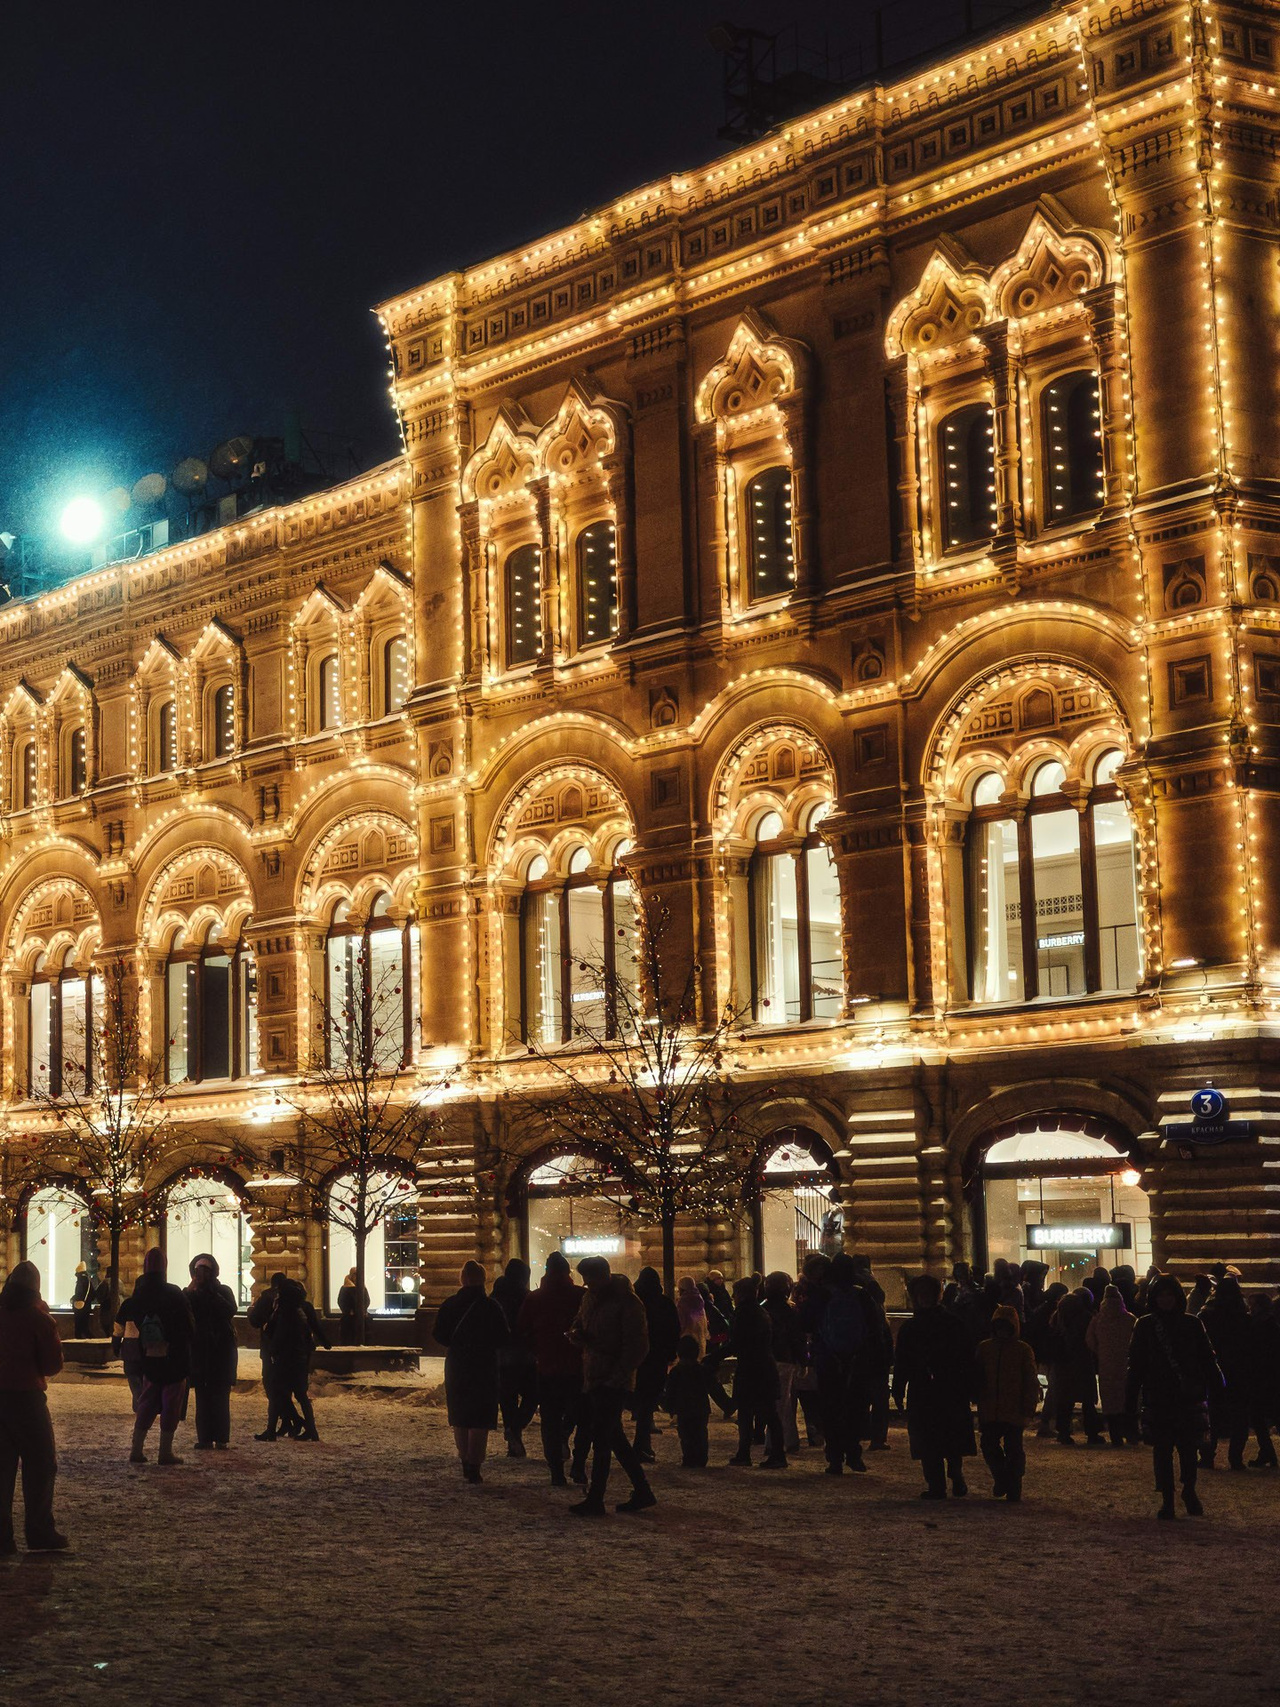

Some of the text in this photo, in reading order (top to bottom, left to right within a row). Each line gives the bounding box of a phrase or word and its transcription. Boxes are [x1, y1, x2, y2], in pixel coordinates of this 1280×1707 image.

[1039, 934, 1085, 949] BURBERRY
[1200, 1094, 1213, 1114] 3
[1191, 1126, 1224, 1134] КРАСНАЯ
[1034, 1227, 1114, 1245] BURBERRY
